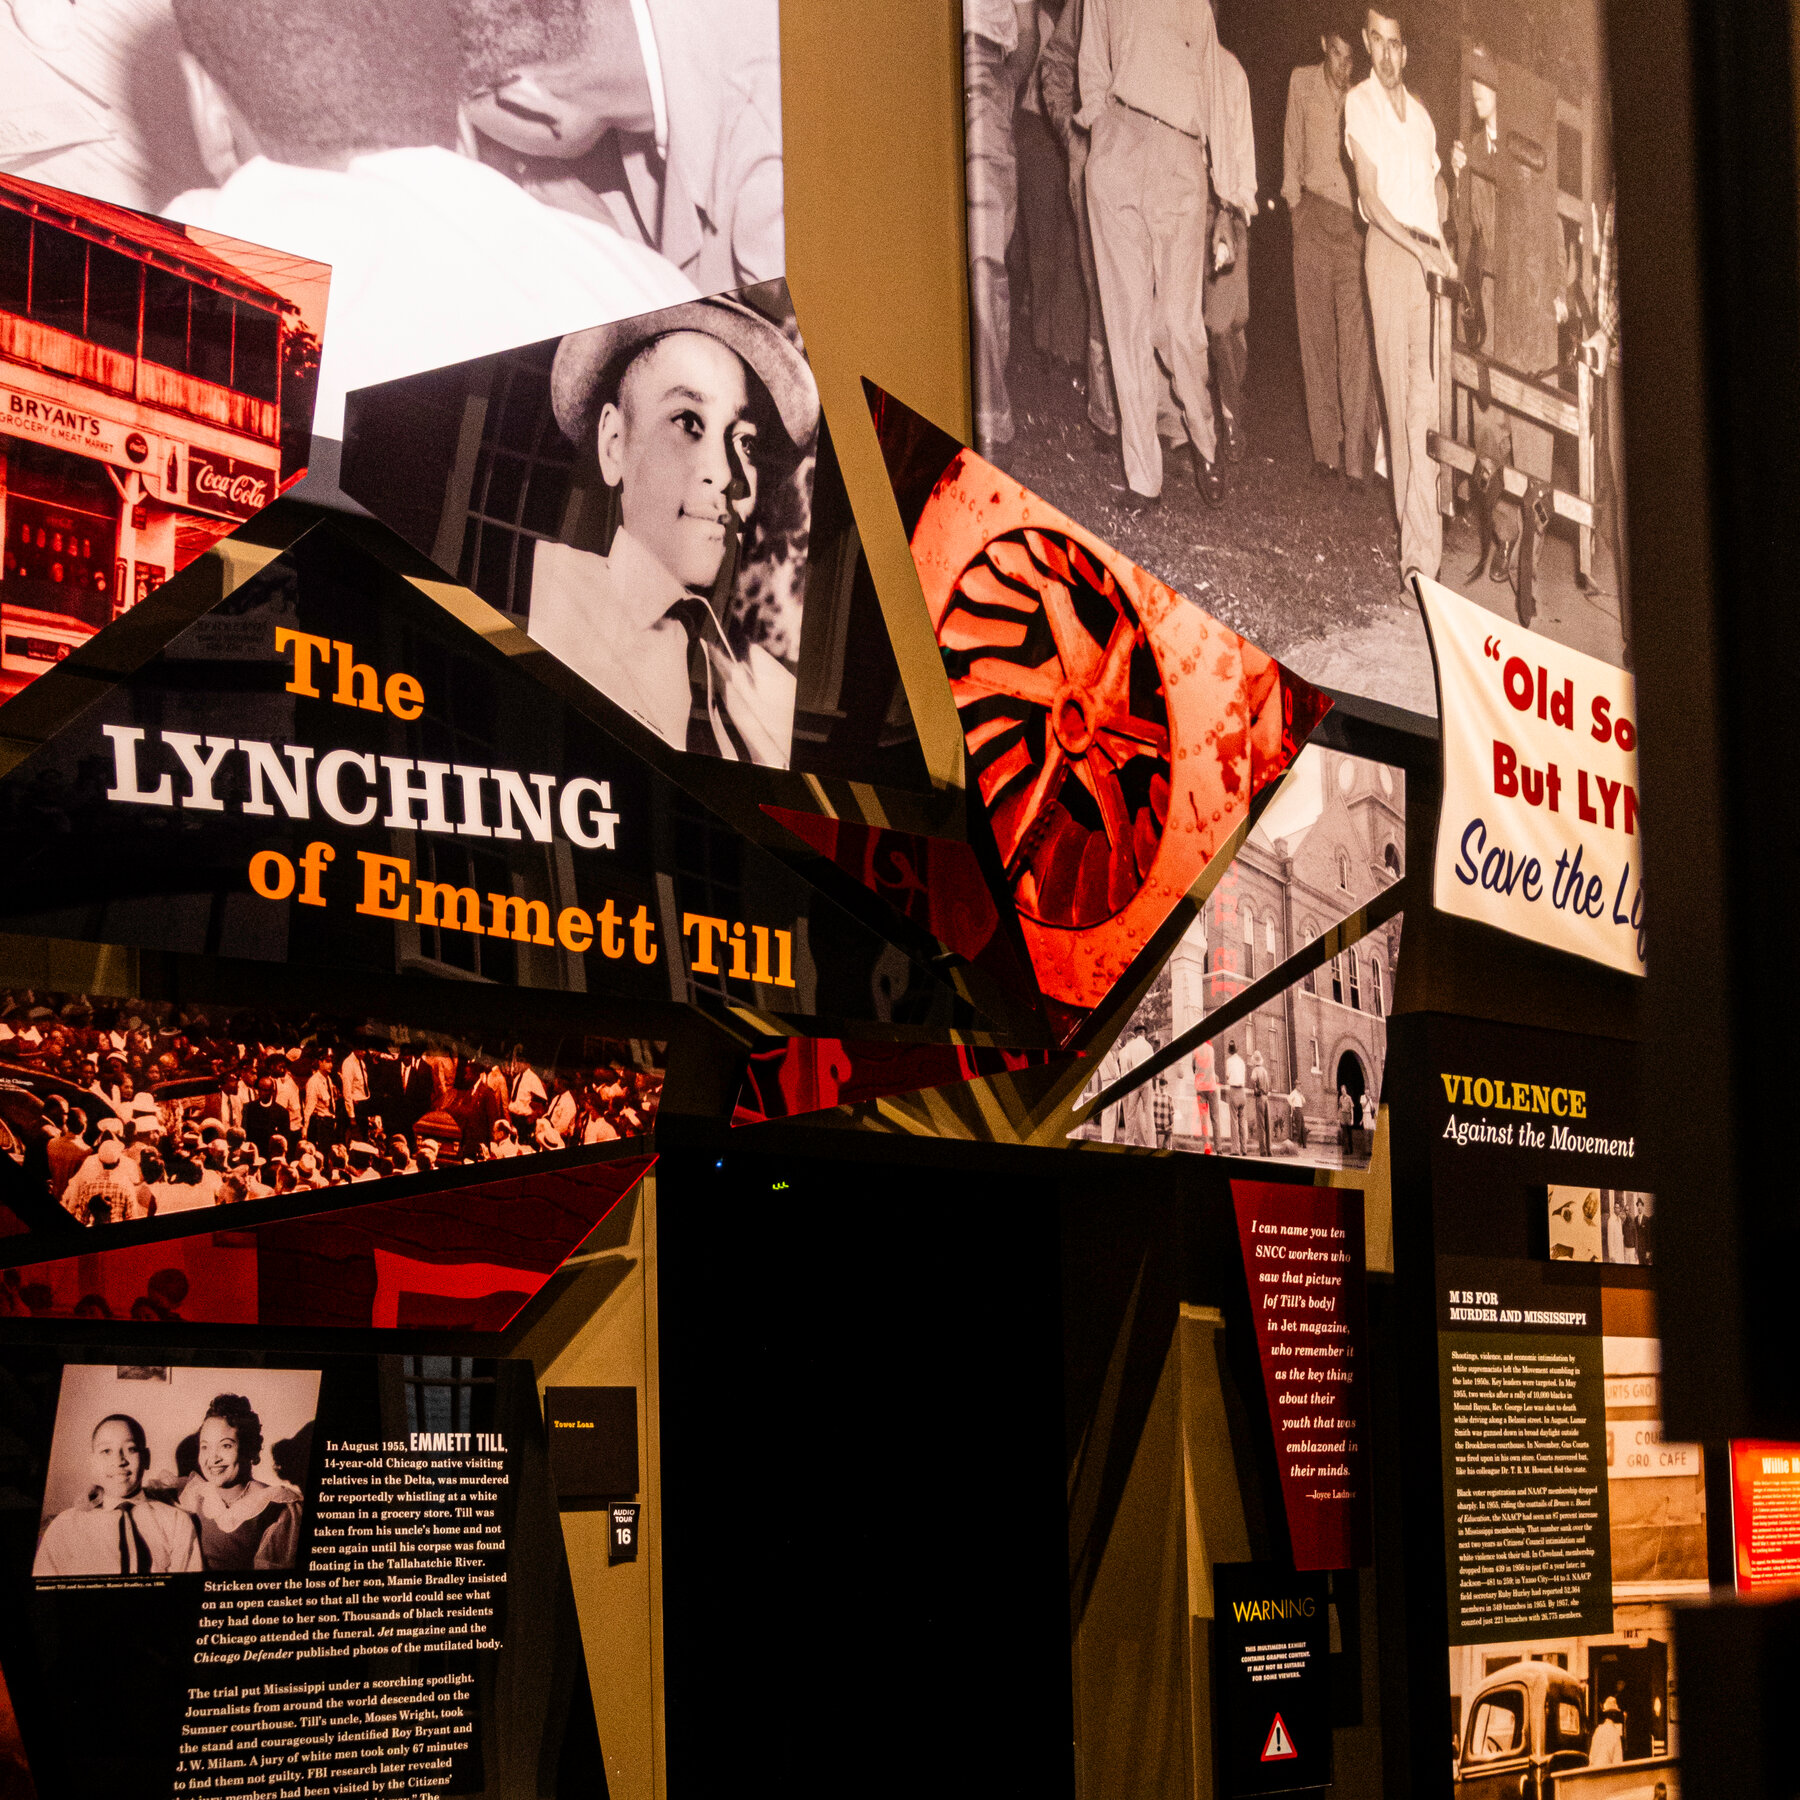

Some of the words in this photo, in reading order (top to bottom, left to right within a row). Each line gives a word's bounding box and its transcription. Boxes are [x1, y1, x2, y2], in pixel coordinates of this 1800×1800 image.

[0, 412, 48, 432] GROCERY
[10, 394, 100, 436] BRYANT'S
[196, 464, 268, 509] Coca-Cola
[275, 626, 425, 721] The
[1493, 739, 1562, 813] But
[103, 724, 620, 850] LYNCHING
[1455, 818, 1544, 903] Save
[1552, 843, 1605, 919] the
[248, 841, 336, 907] of
[356, 850, 658, 965] Emmett
[683, 912, 796, 988] Till
[1441, 1073, 1587, 1119] VIOLENCE
[1442, 1114, 1513, 1146] Against
[1518, 1122, 1545, 1148] the
[1550, 1125, 1635, 1158] Movement
[1251, 1220, 1257, 1233] I
[1258, 1224, 1278, 1234] can
[1280, 1226, 1308, 1236] name
[1309, 1228, 1328, 1239] you
[1330, 1227, 1345, 1238] ten
[1255, 1245, 1286, 1259] SNCC
[1288, 1248, 1329, 1261] workers
[1331, 1250, 1351, 1262] who
[1259, 1273, 1279, 1283] saw
[1282, 1271, 1303, 1284] that
[1305, 1272, 1342, 1287] picture
[1280, 1294, 1306, 1308] Till's
[1449, 1291, 1460, 1303] M
[1462, 1291, 1473, 1304] IS
[1475, 1292, 1498, 1305] FOR
[1450, 1308, 1498, 1322] MURDER
[1500, 1310, 1522, 1323] AND
[1523, 1311, 1587, 1325] MISSISSIPPI
[1267, 1318, 1278, 1331] in
[1280, 1319, 1297, 1332] Jet
[1271, 1343, 1292, 1356] who
[1295, 1344, 1344, 1357] remember
[1347, 1346, 1353, 1357] it
[1275, 1371, 1287, 1380] as
[1289, 1367, 1305, 1380] the
[1307, 1368, 1324, 1383] key
[1279, 1391, 1308, 1404] about
[1310, 1392, 1335, 1404] their
[554, 1420, 575, 1428] Tower
[577, 1420, 594, 1429] Loan
[1282, 1416, 1311, 1431] youth
[1313, 1416, 1334, 1428] that
[1337, 1420, 1356, 1428] was
[327, 1440, 338, 1451] In
[341, 1441, 379, 1453] August
[382, 1441, 408, 1452] 1955,
[410, 1432, 471, 1452] EMMETT
[476, 1433, 508, 1451] TILL,
[1286, 1440, 1346, 1453] emblazoned
[1349, 1441, 1358, 1451] in
[325, 1458, 383, 1470] 14-year-old
[386, 1457, 428, 1470] Chicago
[431, 1458, 463, 1468] native
[465, 1458, 504, 1470] visiting
[1659, 1451, 1687, 1466] CAFE
[1762, 1457, 1790, 1474] Willie
[1290, 1464, 1316, 1477] their
[321, 1475, 368, 1485] relatives
[371, 1475, 382, 1485] in
[384, 1474, 402, 1485] the
[404, 1474, 435, 1486] Delta,
[437, 1477, 457, 1485] was
[459, 1474, 509, 1484] murdered
[319, 1492, 335, 1502] for
[338, 1491, 394, 1504] reportedly
[396, 1491, 446, 1503] whistling
[447, 1492, 458, 1501] at
[469, 1491, 498, 1501] white
[358, 1509, 369, 1519] in
[372, 1511, 378, 1519] a
[381, 1511, 421, 1521] grocery
[424, 1509, 452, 1518] store.
[454, 1507, 472, 1517] Till
[314, 1526, 345, 1536] taken
[348, 1525, 373, 1536] from
[376, 1525, 392, 1535] his
[394, 1524, 431, 1535] uncle's
[433, 1524, 461, 1534] home
[463, 1523, 482, 1534] and
[485, 1525, 501, 1533] not
[616, 1528, 631, 1545] 16
[311, 1546, 336, 1554] seen
[338, 1543, 368, 1555] again
[371, 1542, 397, 1552] until
[399, 1541, 415, 1552] his
[417, 1543, 452, 1553] corpse
[476, 1539, 505, 1550] found
[309, 1560, 351, 1572] floating
[353, 1560, 364, 1570] in
[367, 1559, 384, 1569] the
[386, 1557, 452, 1569] Tallahatchie
[455, 1557, 485, 1567] River.
[1233, 1597, 1316, 1623] WARNING
[187, 1688, 210, 1699] The
[213, 1686, 238, 1698] trial
[241, 1686, 261, 1699] put
[263, 1681, 325, 1695] Mississippi
[328, 1679, 361, 1691] under
[363, 1681, 370, 1689] a
[372, 1676, 424, 1688] scorching
[426, 1673, 475, 1687] spotlight.
